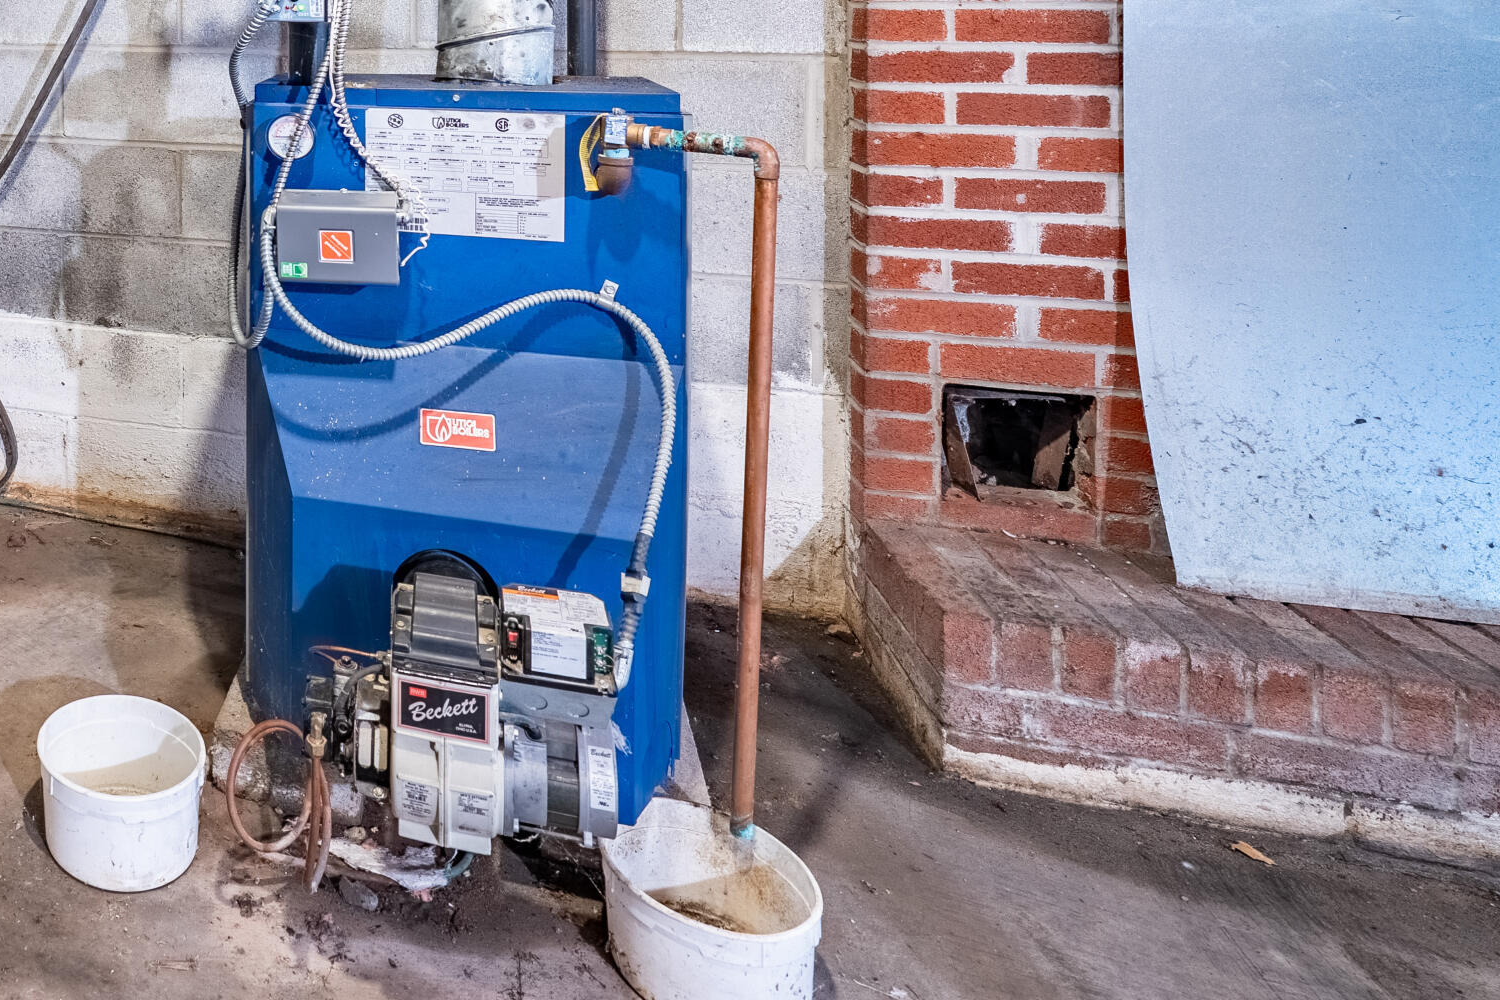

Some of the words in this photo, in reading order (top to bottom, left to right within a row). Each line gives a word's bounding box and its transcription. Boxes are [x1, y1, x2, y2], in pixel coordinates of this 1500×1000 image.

[452, 418, 476, 427] UTICA
[452, 426, 489, 438] BOILERS
[408, 697, 478, 722] Beckett
